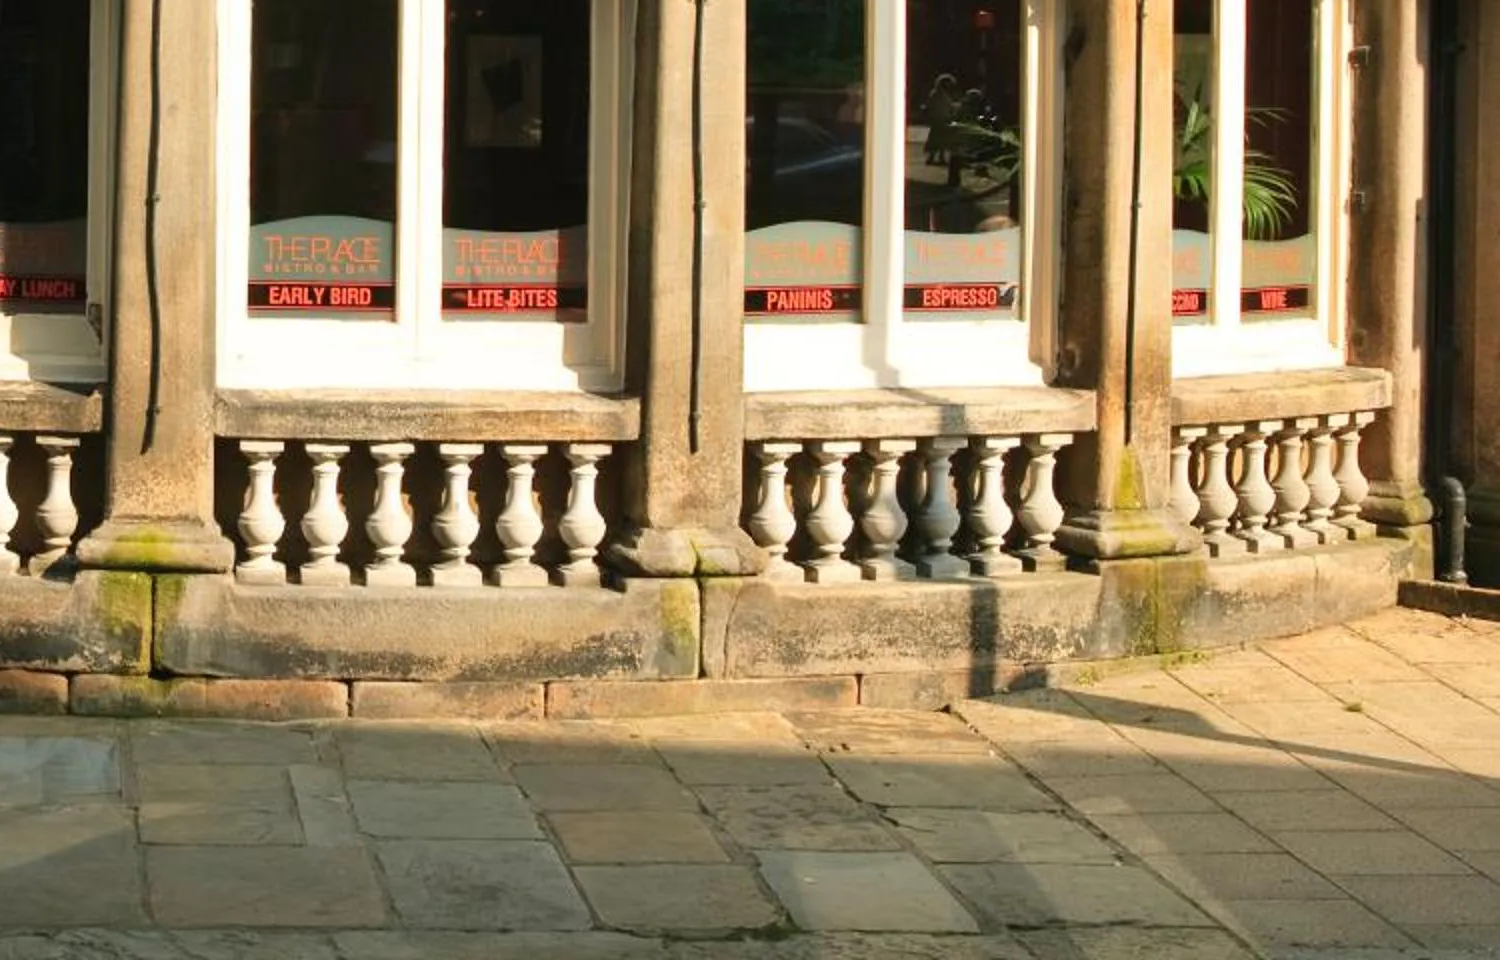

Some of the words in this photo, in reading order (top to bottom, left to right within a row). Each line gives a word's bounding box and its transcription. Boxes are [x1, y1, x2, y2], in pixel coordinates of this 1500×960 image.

[264, 236, 309, 261] THE
[311, 236, 382, 263] PLACE
[455, 238, 500, 262] THE
[21, 278, 77, 299] LUNCH
[268, 286, 325, 306] EARLY
[330, 287, 372, 306] BIRD
[467, 289, 504, 308] LITE
[507, 289, 558, 308] BITES
[922, 287, 998, 307] ESPRESSO
[766, 289, 834, 311] PANINIS
